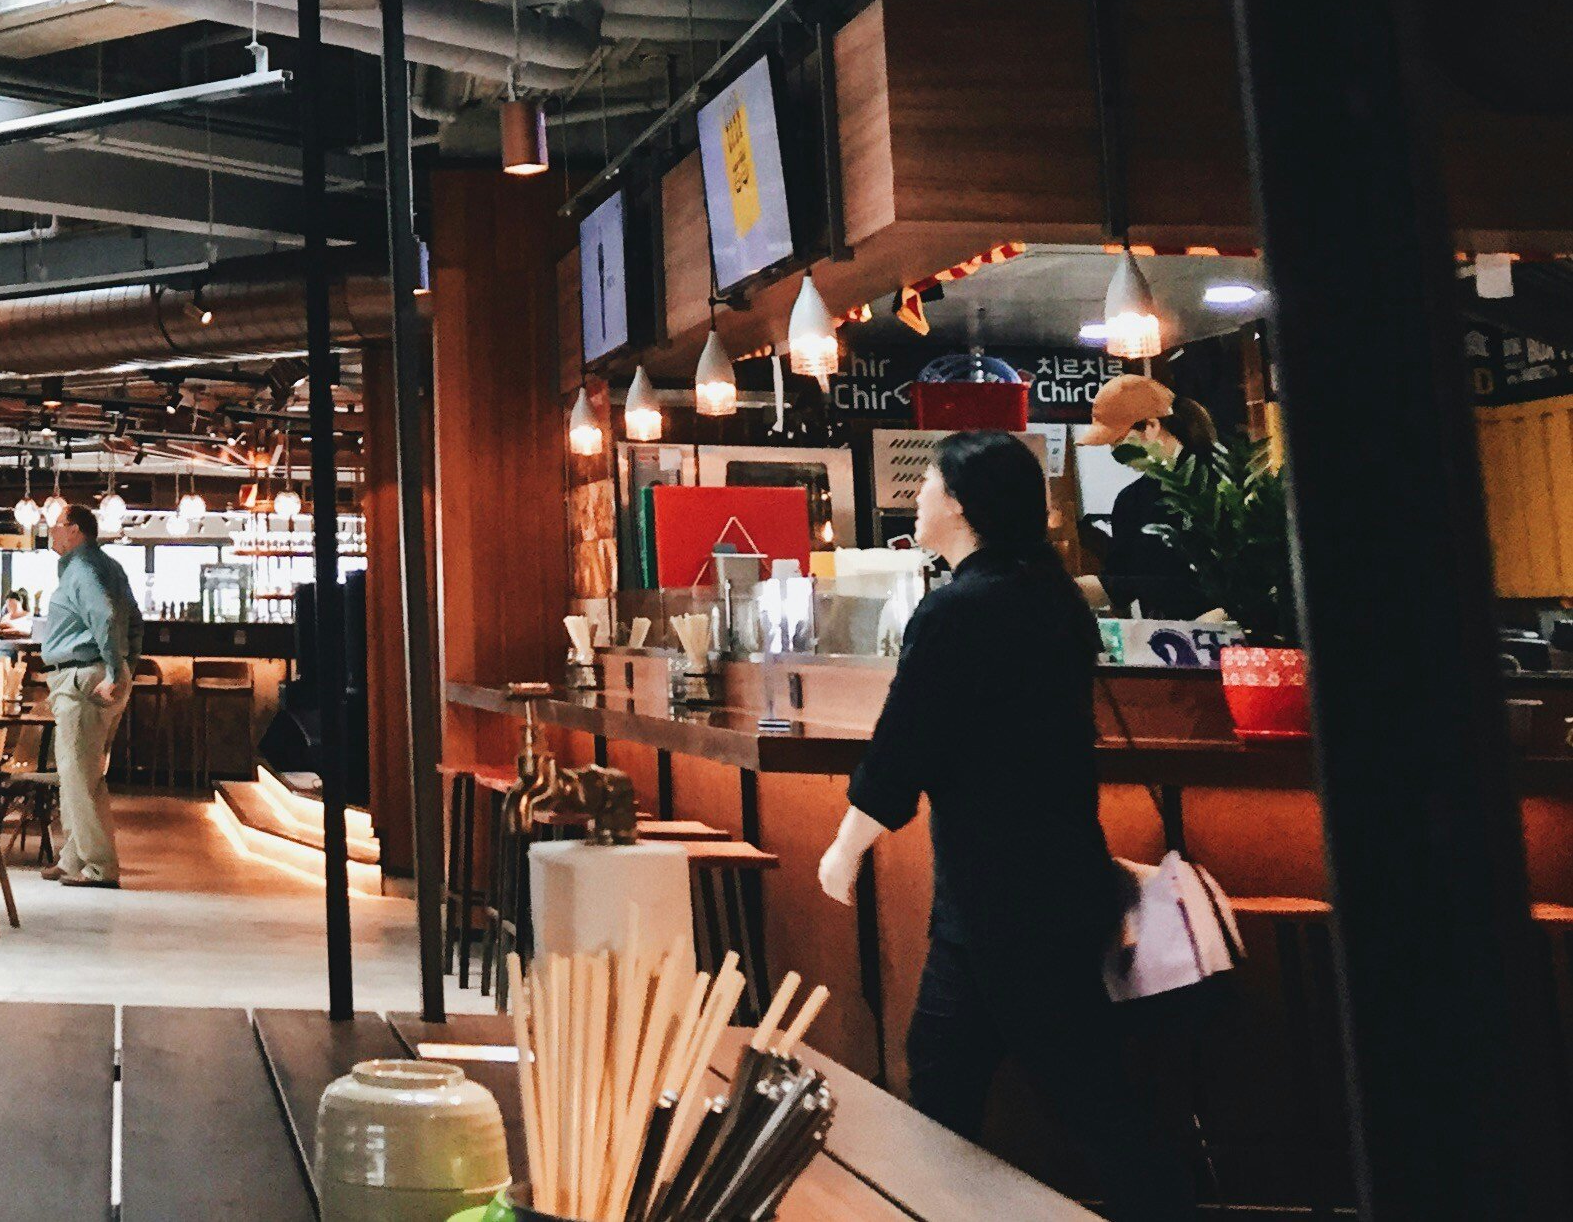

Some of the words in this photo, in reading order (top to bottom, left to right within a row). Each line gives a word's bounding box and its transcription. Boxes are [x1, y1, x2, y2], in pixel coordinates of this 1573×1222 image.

[837, 351, 891, 378] hir
[834, 383, 892, 410] Chir
[1036, 381, 1104, 403] ChirC
